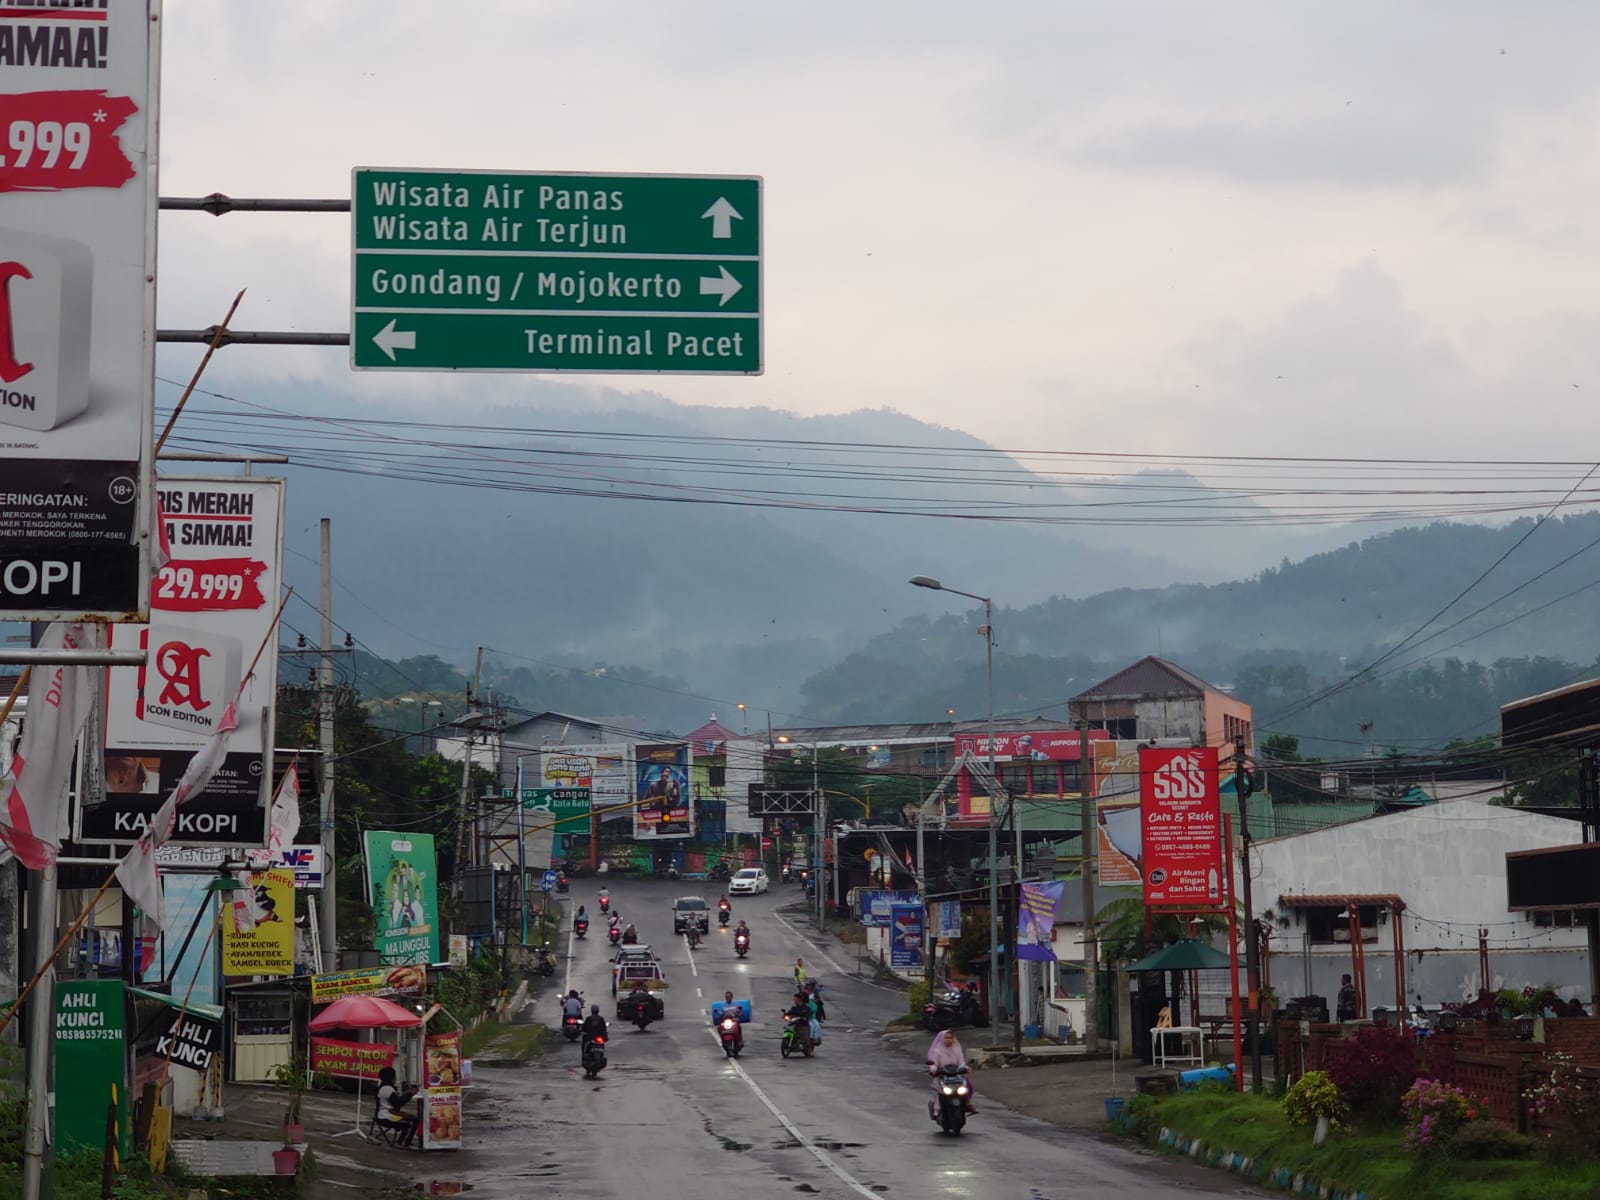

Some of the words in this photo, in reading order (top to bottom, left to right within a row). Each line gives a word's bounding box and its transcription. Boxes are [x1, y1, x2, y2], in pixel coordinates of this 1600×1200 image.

[373, 181, 469, 208] Wisata
[482, 184, 524, 210] Air
[539, 186, 624, 212] Panas
[373, 215, 468, 242] Wisata
[482, 218, 522, 242] Air
[537, 218, 626, 247] Terjun
[372, 269, 501, 302] Gondang
[510, 272, 524, 300] /
[538, 270, 682, 303] Mojokerto
[524, 330, 652, 356] Terminal
[667, 331, 744, 357] Pacet
[0, 493, 88, 507] ERINGATAN:
[112, 485, 132, 496] 18+
[188, 491, 254, 515] MERAH
[70, 512, 107, 520] TERKENA
[26, 530, 66, 538] MEROKOK
[181, 523, 253, 547] SAMAA!
[0, 560, 81, 596] OPI
[146, 703, 170, 718] ICON
[173, 708, 212, 727] EDITION
[554, 791, 588, 800] Cangar
[178, 812, 238, 834] KOPI
[1174, 812, 1184, 822] &
[62, 992, 96, 1008] AHLI
[56, 1012, 104, 1028] KUNCI
[169, 1020, 213, 1045] AHLI
[156, 1036, 213, 1068] KUNCI
[317, 1060, 347, 1070] AYAM
